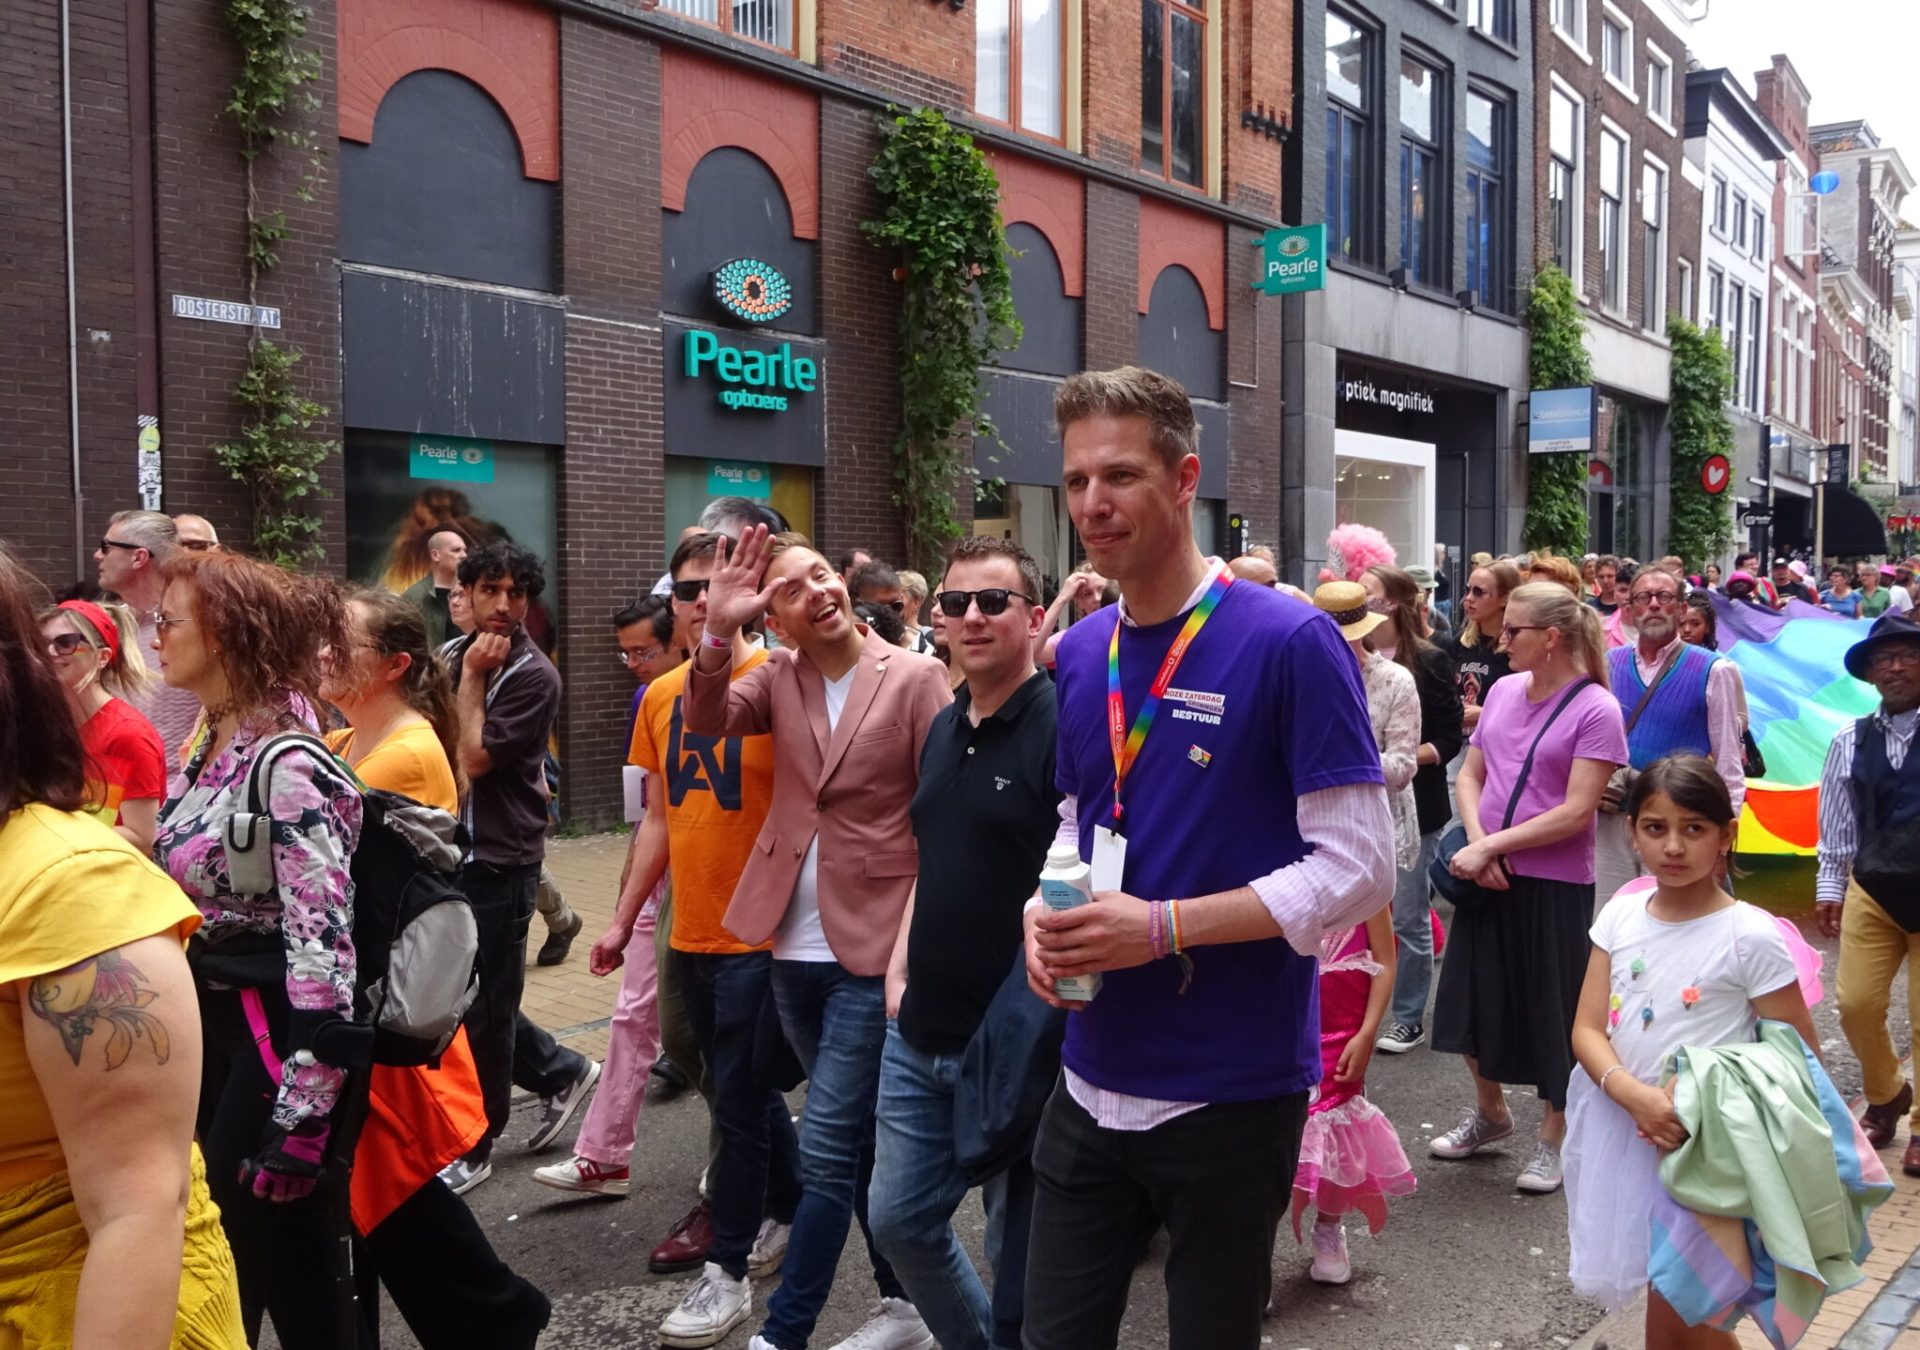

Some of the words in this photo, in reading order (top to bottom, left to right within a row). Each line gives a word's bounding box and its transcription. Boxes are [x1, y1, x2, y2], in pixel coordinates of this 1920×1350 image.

[1268, 257, 1318, 278] Pearle
[685, 329, 817, 392] Pearle
[720, 388, 788, 411] opticiens
[1380, 391, 1434, 413] magnifiek
[420, 443, 457, 459] Pearle
[714, 465, 743, 478] Pearle
[1460, 662, 1489, 675] LOLA
[1184, 692, 1222, 703] ZATERDAG
[1172, 709, 1221, 725] BESTUUR
